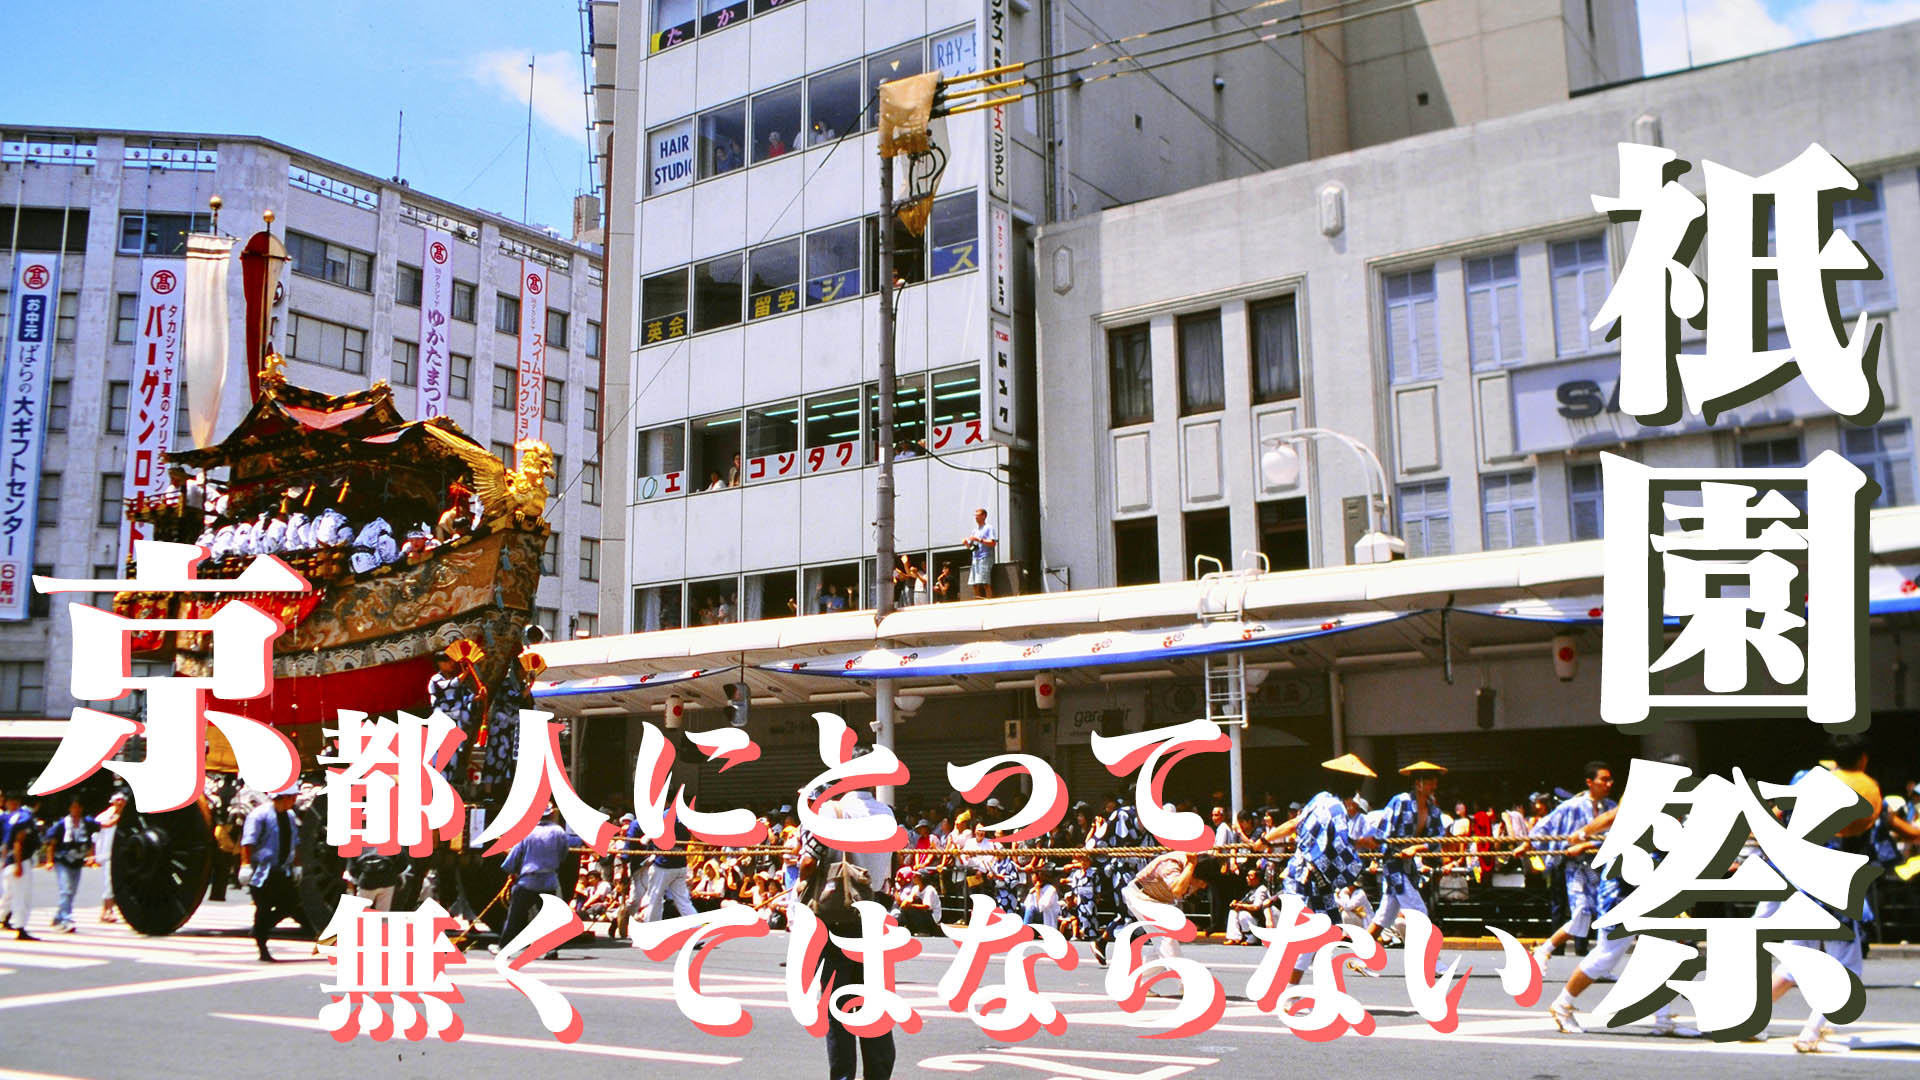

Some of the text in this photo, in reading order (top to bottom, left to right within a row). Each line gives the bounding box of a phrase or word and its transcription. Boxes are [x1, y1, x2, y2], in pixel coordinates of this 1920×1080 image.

[660, 134, 689, 159] HAIR
[23, 299, 41, 339] お中元
[423, 309, 445, 418] ゆかたまつり
[530, 333, 544, 418] スイムスーツ
